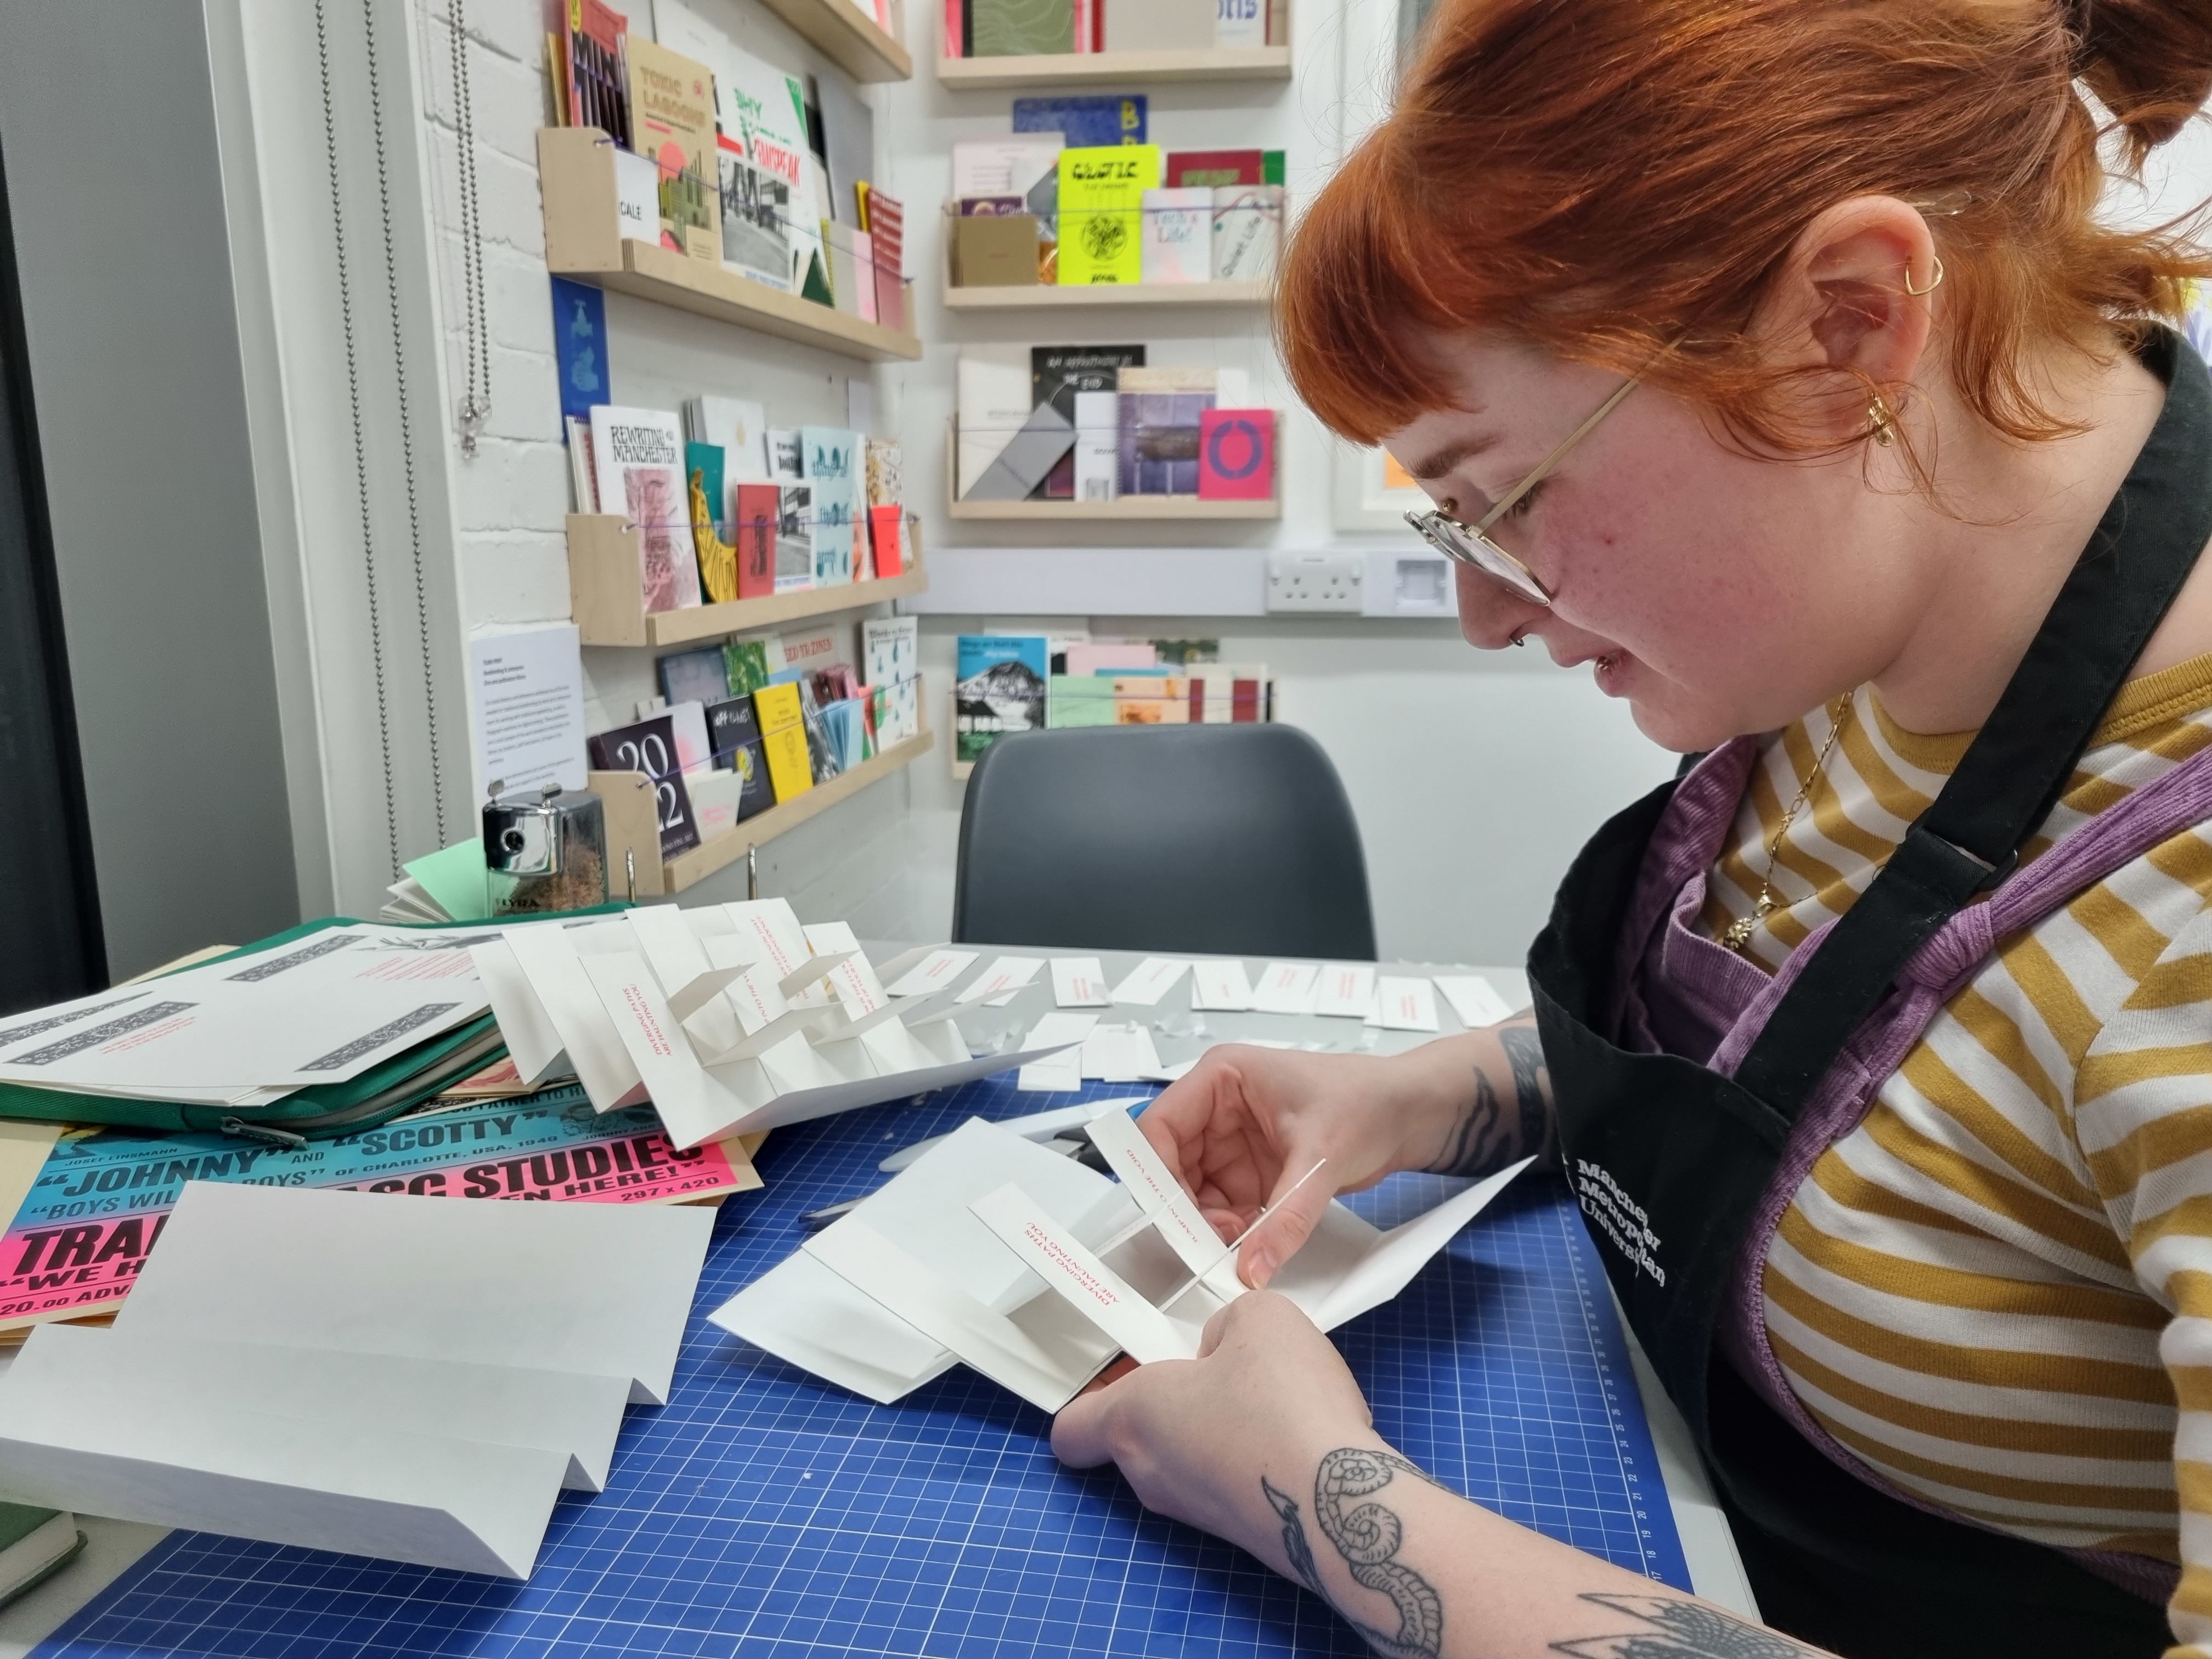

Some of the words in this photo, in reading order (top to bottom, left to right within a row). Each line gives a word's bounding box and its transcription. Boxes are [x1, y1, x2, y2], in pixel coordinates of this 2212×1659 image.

[610, 426, 665, 447] REWRITING
[613, 445, 678, 464] MANCHESTER
[616, 733, 668, 778] 20
[658, 781, 684, 833] 2
[623, 988, 640, 1012] PATHS
[630, 983, 643, 1000] YOU
[747, 983, 758, 997] THE
[755, 998, 768, 1020] INTO
[640, 1001, 665, 1041] HAUNTING
[637, 1013, 663, 1055] DIVERGING
[661, 1042, 673, 1056] ARE
[545, 1090, 564, 1102] TO
[582, 1128, 629, 1140] JOHNNY
[65, 1157, 108, 1166] JOSEF
[109, 1148, 178, 1160] EINSMANN
[335, 1167, 358, 1176] OF
[363, 1152, 468, 1172] CHARLOTTE,
[472, 1144, 512, 1155] USA,
[519, 1135, 558, 1147] 1949
[463, 1132, 703, 1199] STUDIES
[1127, 1149, 1145, 1173] VOID
[36, 1144, 294, 1197] “JOHNNY”
[291, 1152, 325, 1164] AND
[565, 1160, 705, 1196] HERE!”
[1145, 1176, 1159, 1193] THE
[31, 1197, 121, 1220] “BOYS
[1578, 1159, 1662, 1252] Mancheer
[1026, 1222, 1048, 1242] YOU
[1178, 1219, 1199, 1243] JUMP
[0, 1297, 70, 1315] 20.00
[620, 1188, 661, 1202] 297
[680, 1177, 720, 1189] 420
[1024, 1229, 1056, 1257] PATHS
[1049, 1242, 1100, 1286] HAUNTING
[1056, 1258, 1110, 1306] DIVERGING
[1099, 1286, 1121, 1303] ARE
[1623, 1457, 1633, 1465] 23
[1628, 1474, 1638, 1482] 22
[1633, 1492, 1642, 1500] 21
[1637, 1510, 1647, 1520] 20
[1641, 1530, 1651, 1538] 19
[1646, 1550, 1657, 1559] 18
[1651, 1570, 1662, 1580] 17
